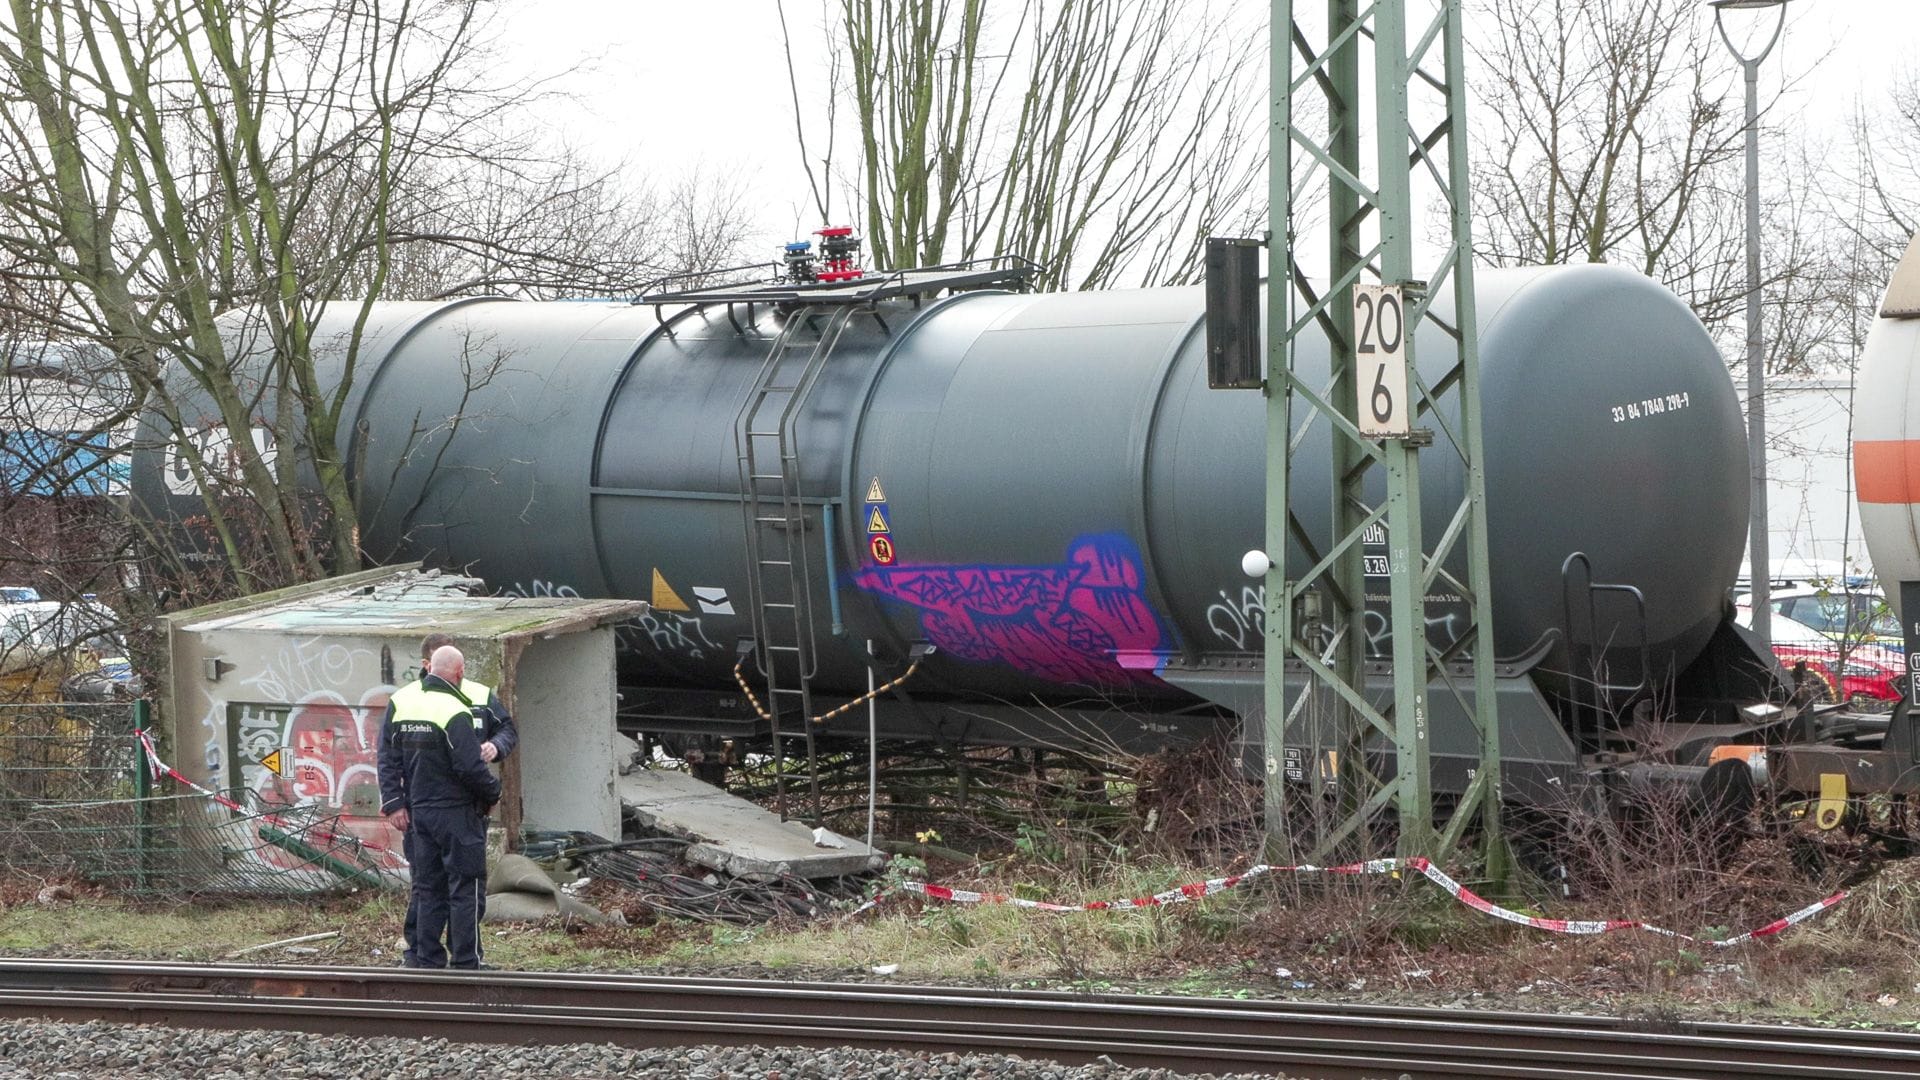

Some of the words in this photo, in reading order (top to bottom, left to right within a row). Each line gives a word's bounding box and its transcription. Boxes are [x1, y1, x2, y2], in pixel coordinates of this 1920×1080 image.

[1355, 292, 1402, 354] 20
[1371, 363, 1393, 424] 6
[1611, 406, 1625, 423] 33
[1627, 402, 1641, 420] 84
[1642, 397, 1665, 417] 7840
[1666, 391, 1689, 411] 298-9
